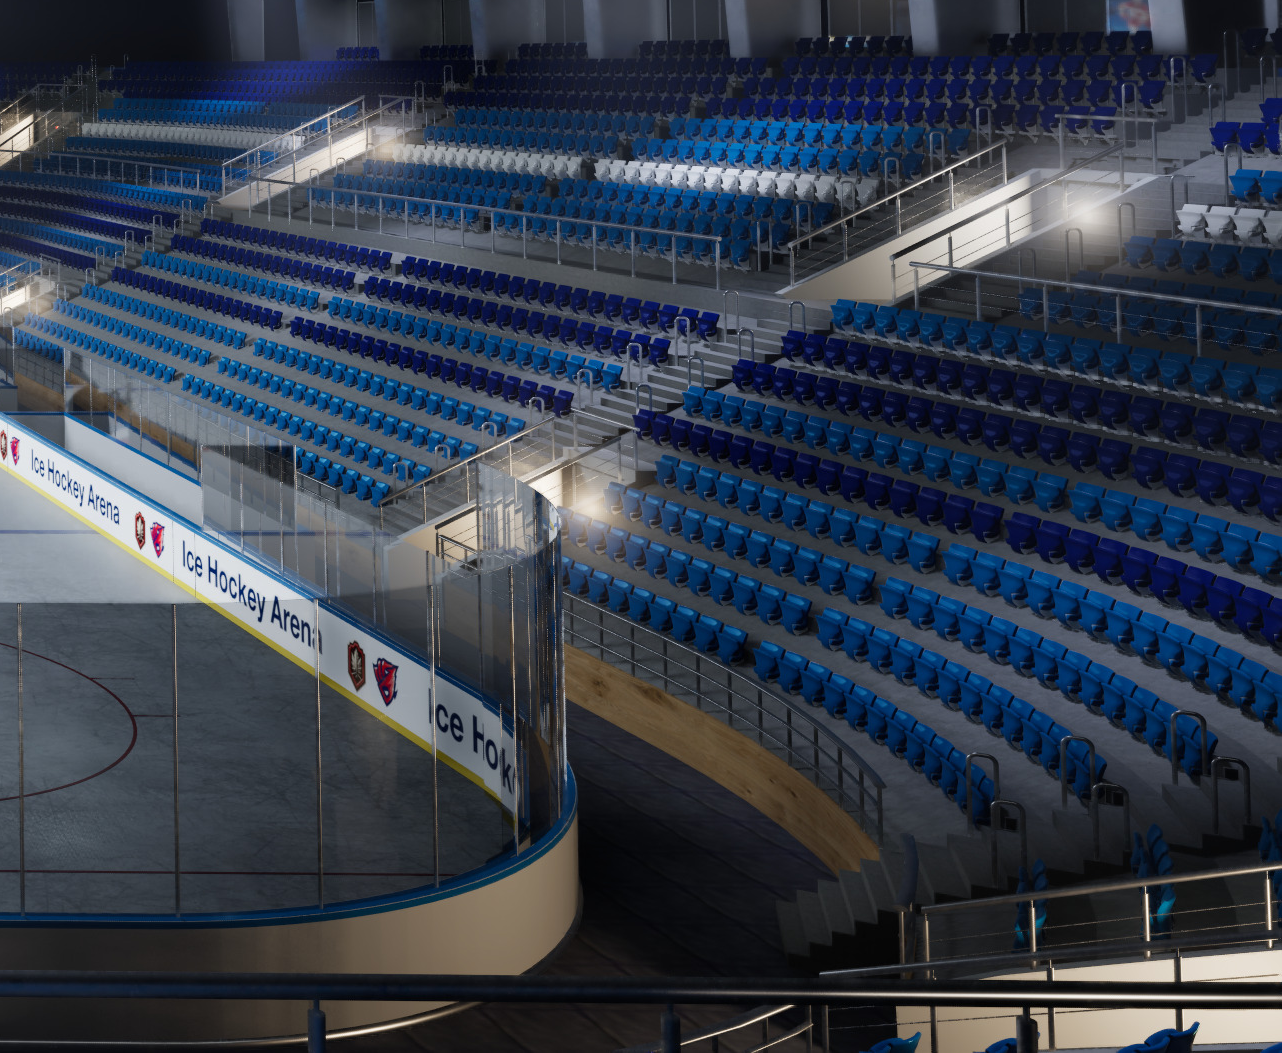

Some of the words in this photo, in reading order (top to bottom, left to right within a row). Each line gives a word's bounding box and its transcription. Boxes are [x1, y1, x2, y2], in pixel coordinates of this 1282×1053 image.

[31, 448, 45, 477] Ice
[48, 459, 85, 506] Hockey
[88, 484, 120, 525] Arena
[182, 540, 203, 578] Ice
[207, 555, 266, 623] Hockey
[271, 595, 323, 653] Arena
[428, 688, 464, 742] Ice
